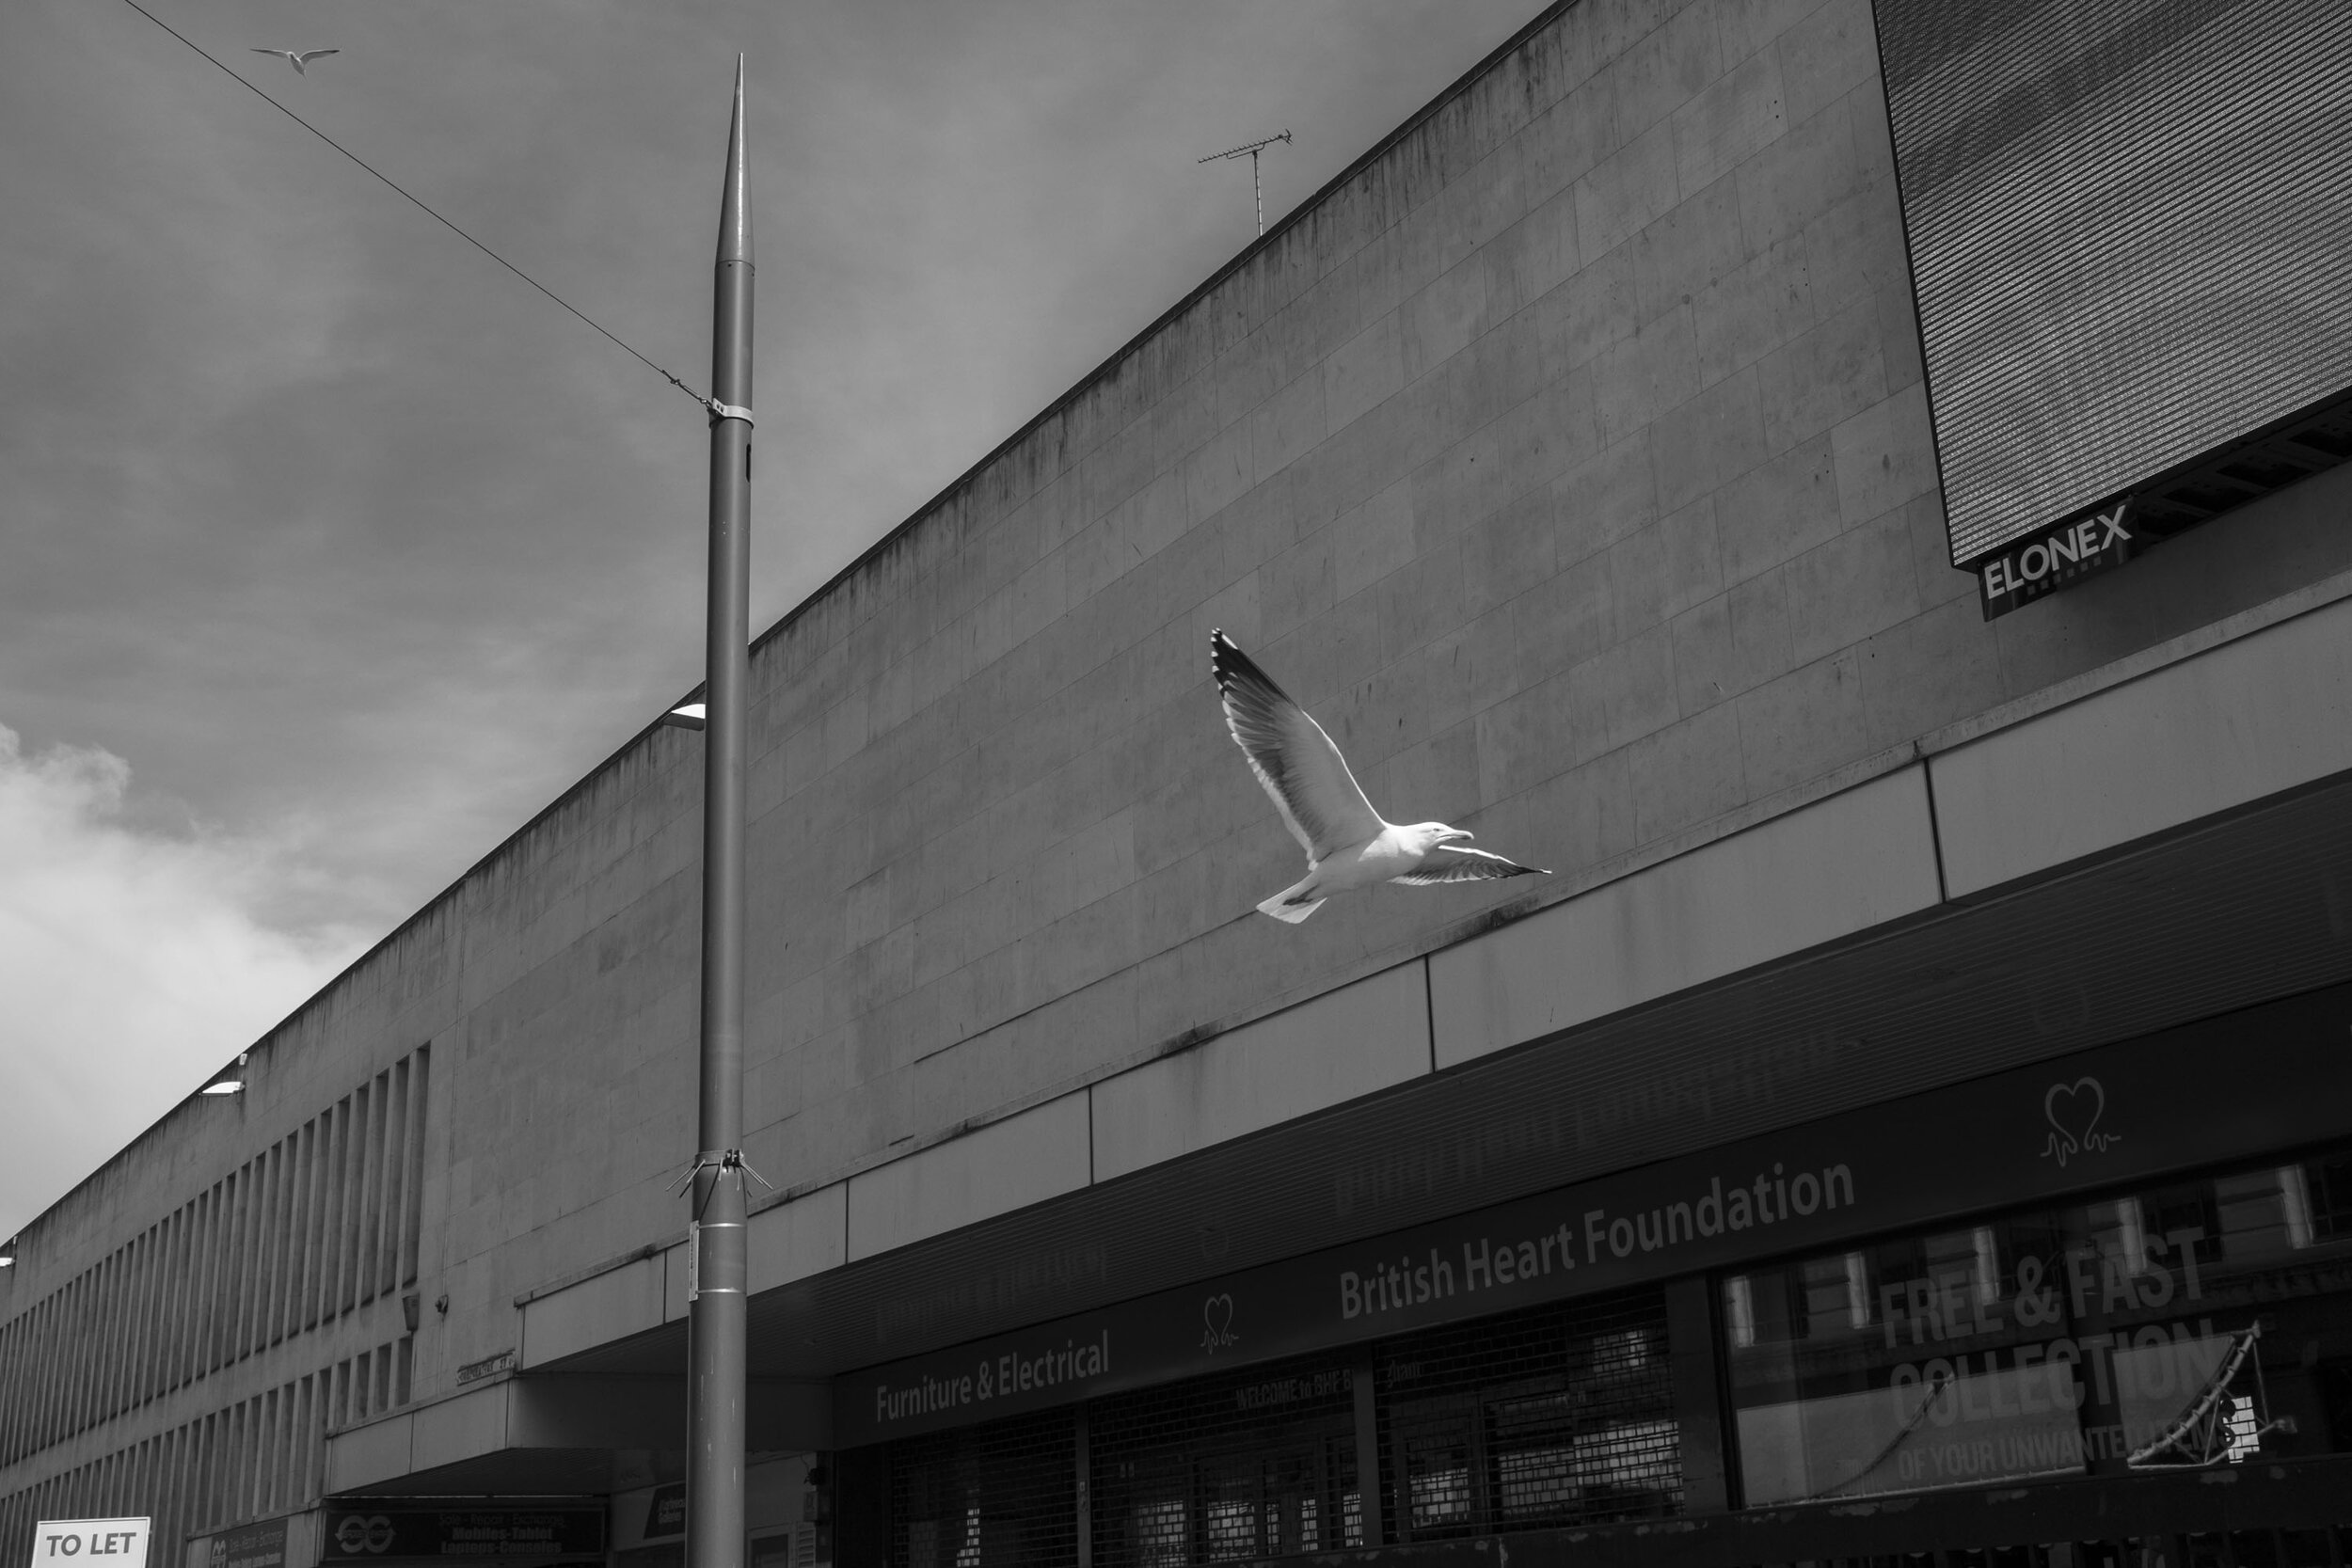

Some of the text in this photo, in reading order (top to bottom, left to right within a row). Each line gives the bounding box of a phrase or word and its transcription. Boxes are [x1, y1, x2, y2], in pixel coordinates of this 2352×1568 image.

[1984, 504, 2133, 600] ELONEX
[1340, 1162, 1855, 1321] British Heart Foundation
[1880, 1226, 2205, 1349] FREE & FAST
[876, 1328, 1109, 1423] Furniture & Electrical
[1236, 1378, 1298, 1410] WELCOME
[1889, 1319, 2220, 1429] COLLECTION
[1899, 1449, 1927, 1482] OF
[1929, 1440, 1995, 1478] YOUR
[46, 1532, 137, 1557] TO LET
